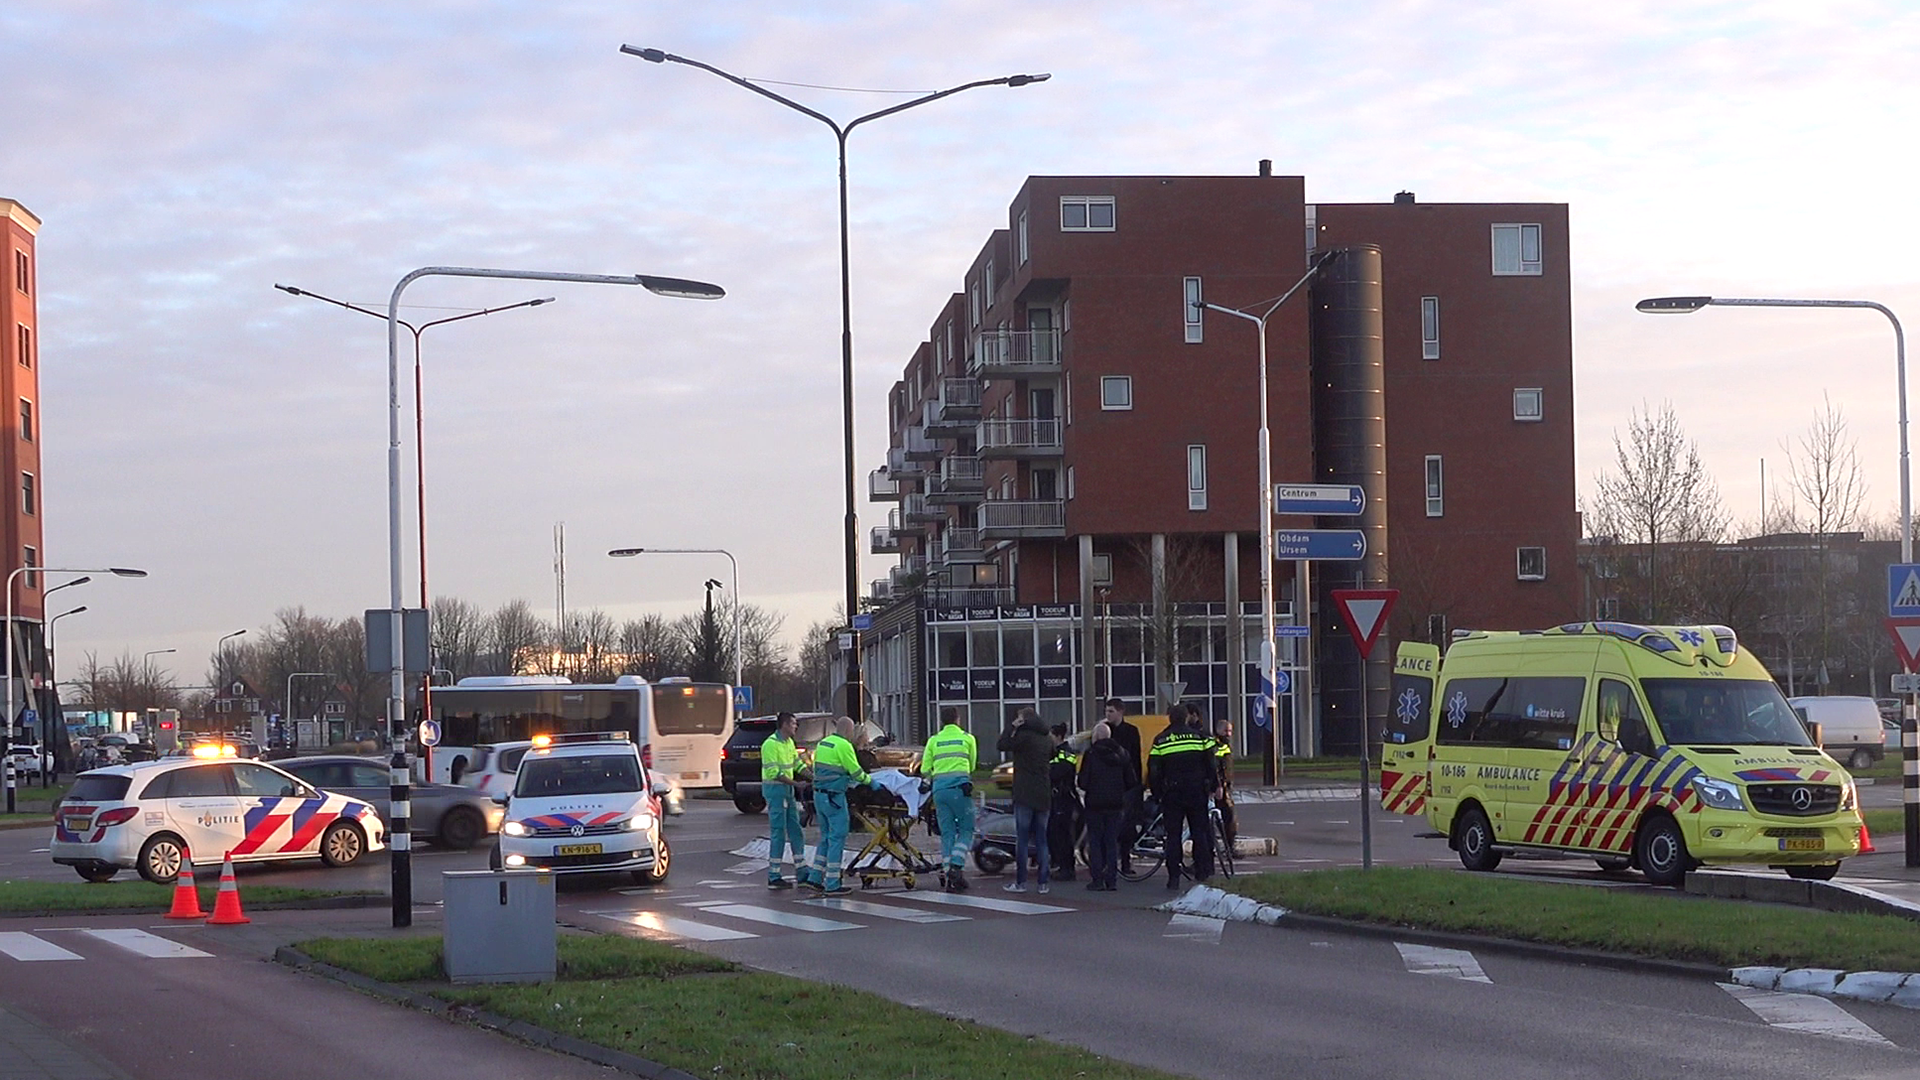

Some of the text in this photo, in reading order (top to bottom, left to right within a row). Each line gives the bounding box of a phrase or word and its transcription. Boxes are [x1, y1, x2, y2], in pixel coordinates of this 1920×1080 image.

[1281, 489, 1317, 497] Centrum
[1280, 534, 1310, 542] Obdam
[1280, 546, 1307, 554] Ursem
[1534, 707, 1566, 719] witte kruis
[1734, 757, 1824, 767] AMBULANCE
[1441, 764, 1466, 778] 10-186
[1477, 766, 1541, 781] AMBULANCE
[197, 811, 240, 827] POLITIE
[561, 846, 599, 854] KN-916-L
